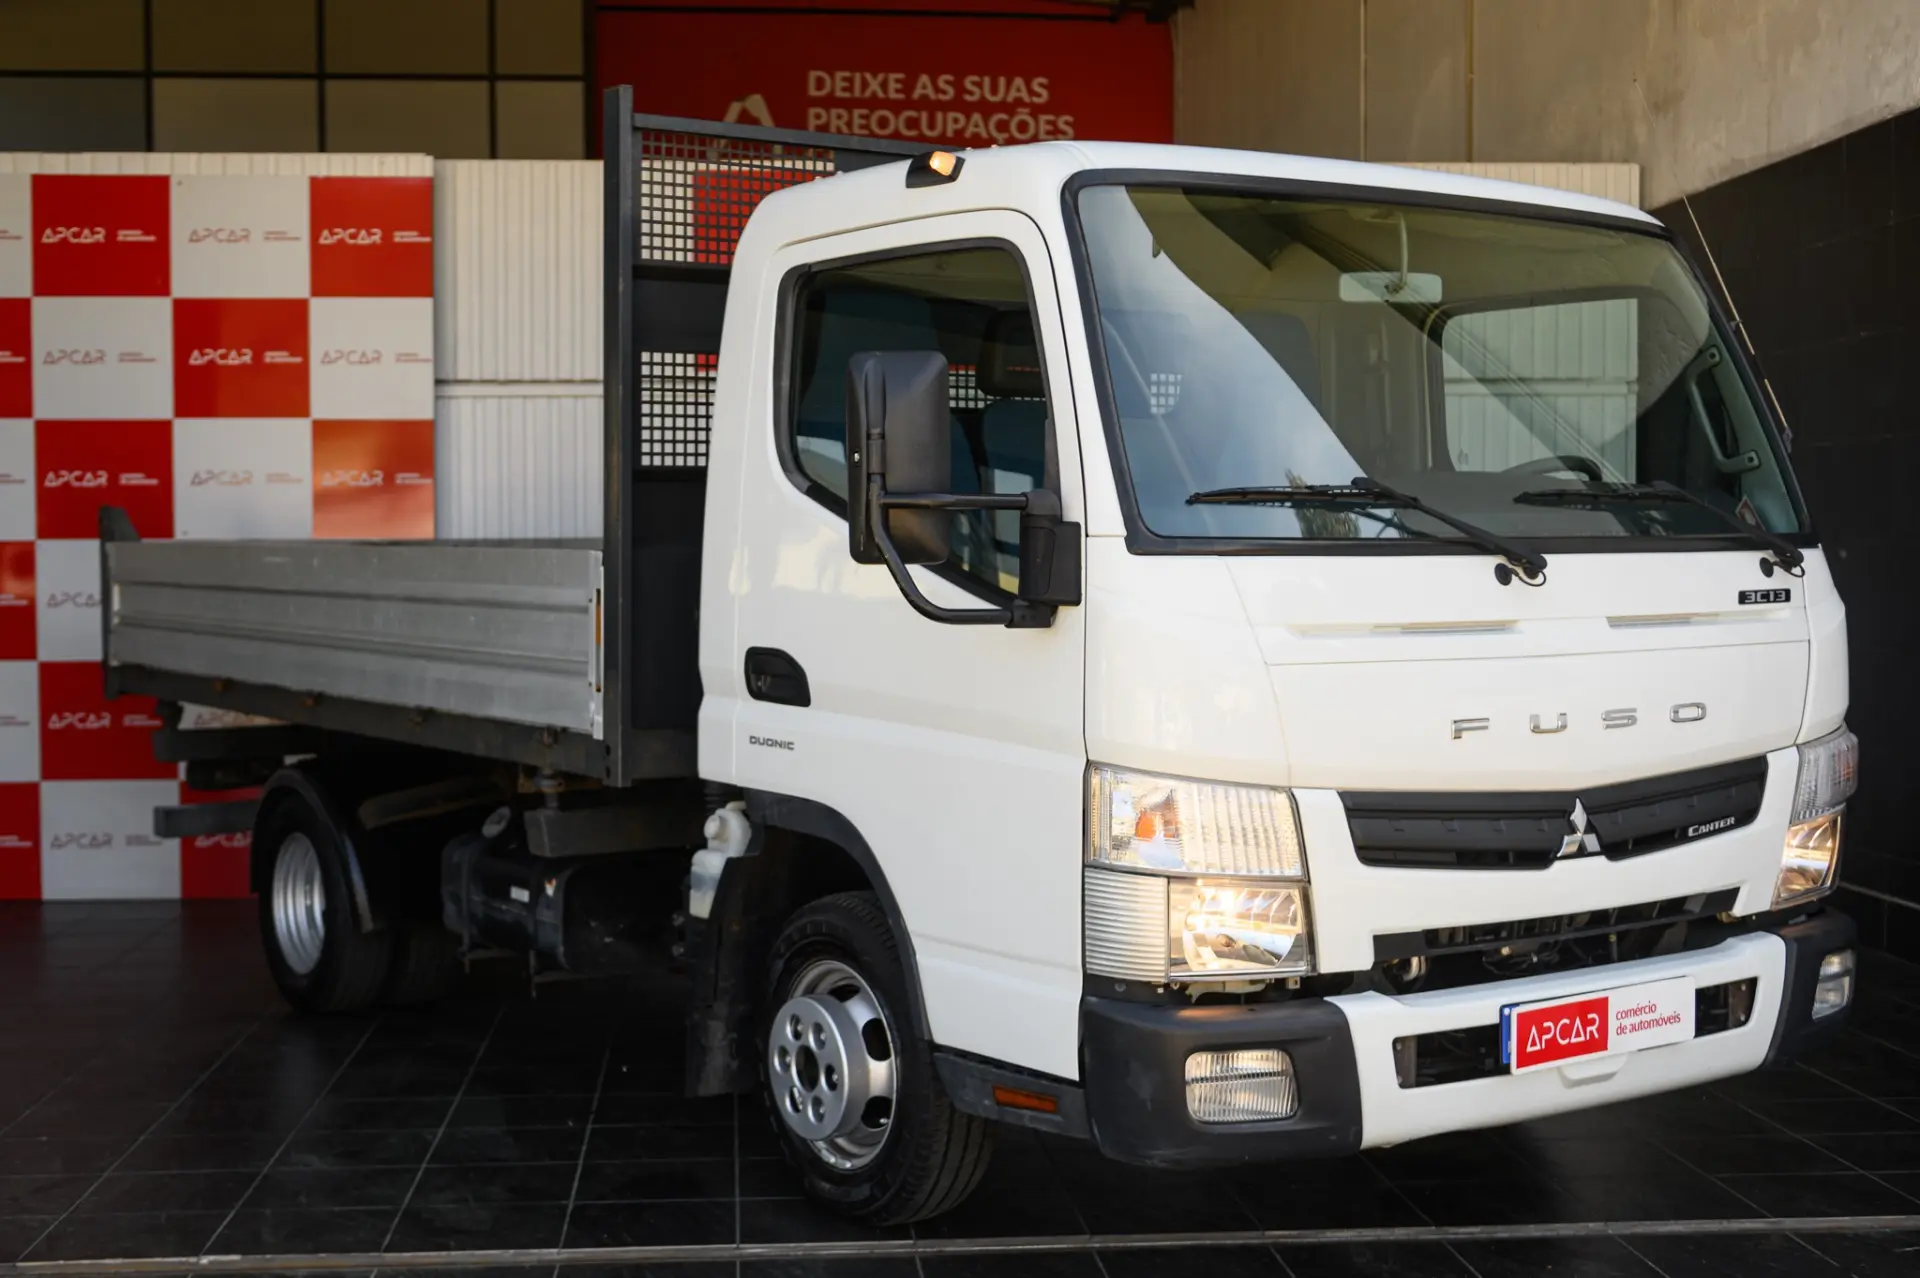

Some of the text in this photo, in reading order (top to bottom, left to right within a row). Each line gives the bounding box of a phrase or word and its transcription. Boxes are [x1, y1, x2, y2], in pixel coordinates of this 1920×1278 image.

[807, 70, 1050, 104] DEIXE AS SUAS
[807, 107, 1075, 143] PREOCUPAÇÕES
[41, 227, 105, 244] APCAR
[188, 228, 251, 244] APCAR
[318, 228, 382, 244] APCAR
[189, 349, 252, 365] APCAR
[320, 349, 382, 365] APCAR
[44, 470, 107, 487] APCAR
[320, 470, 383, 487] APCAR
[46, 592, 102, 608] APCA
[1744, 590, 1786, 604] 3C13
[1450, 701, 1707, 740] FUSO
[749, 735, 795, 751] DUONIC
[1688, 816, 1735, 838] CANTER
[1616, 1000, 1657, 1020] comércio
[1616, 1012, 1681, 1036] de automóveis
[1526, 1013, 1600, 1053] APCAR
